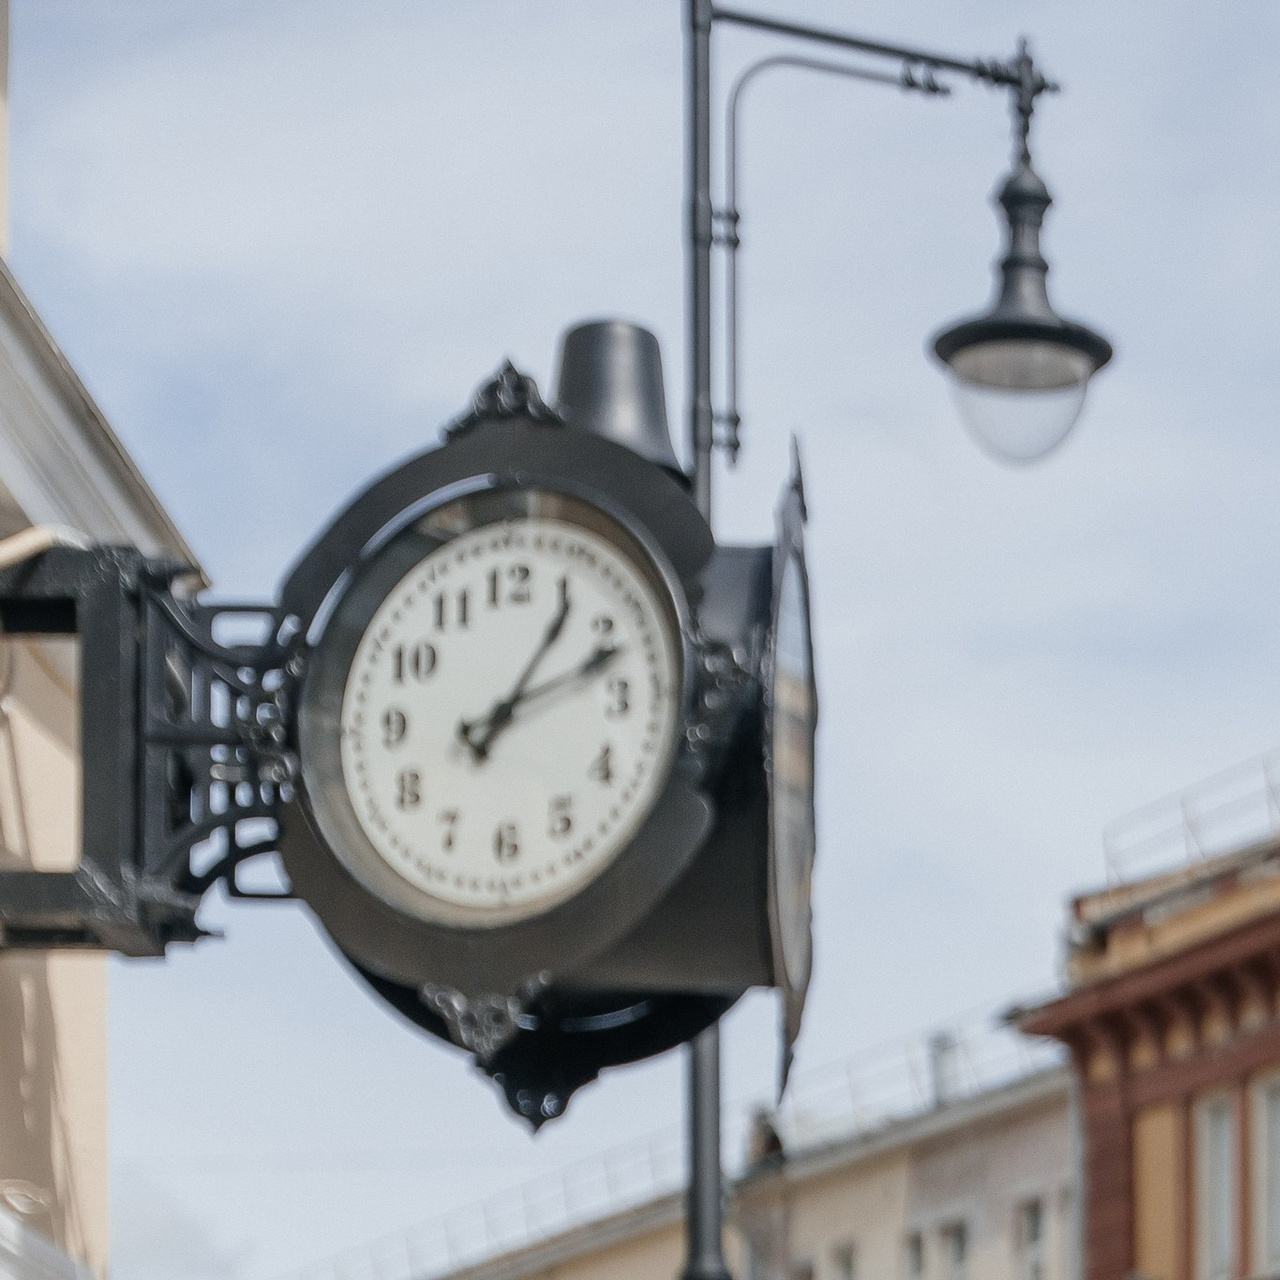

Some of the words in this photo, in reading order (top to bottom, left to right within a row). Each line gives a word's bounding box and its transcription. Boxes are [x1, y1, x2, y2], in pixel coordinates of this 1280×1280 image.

[487, 564, 531, 608] 12
[434, 588, 469, 632] 11
[393, 643, 438, 686] 10
[606, 678, 630, 717] 3
[382, 707, 407, 752] 9
[587, 743, 614, 787] 4
[398, 770, 421, 811] 8
[437, 807, 460, 853] 7
[548, 794, 572, 839] 5
[494, 822, 520, 864] 6
